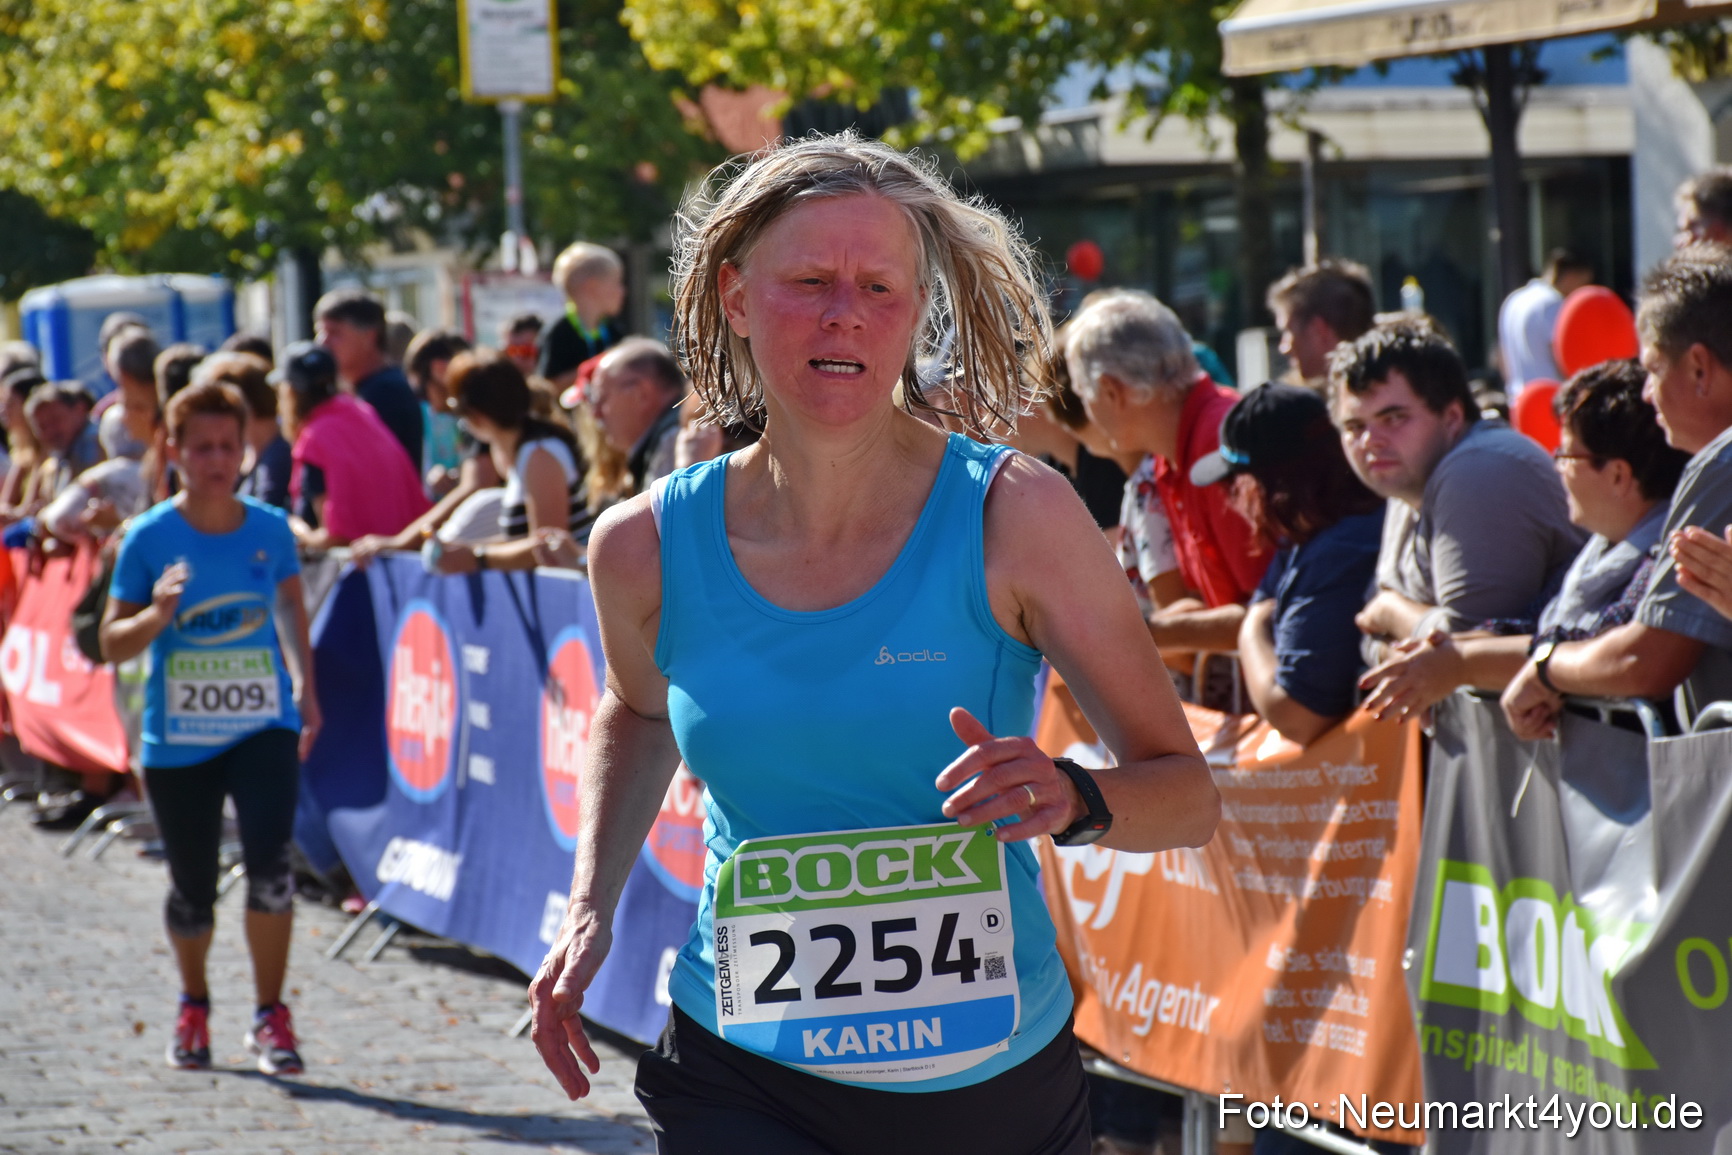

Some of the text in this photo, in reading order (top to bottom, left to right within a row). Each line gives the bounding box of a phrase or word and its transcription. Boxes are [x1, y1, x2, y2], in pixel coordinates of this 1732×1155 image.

[897, 648, 947, 662] odlo
[180, 682, 266, 712] 2009
[738, 836, 970, 900] BOCK
[986, 913, 999, 928] D
[749, 912, 982, 1006] 2254
[802, 1016, 943, 1059] KARIN
